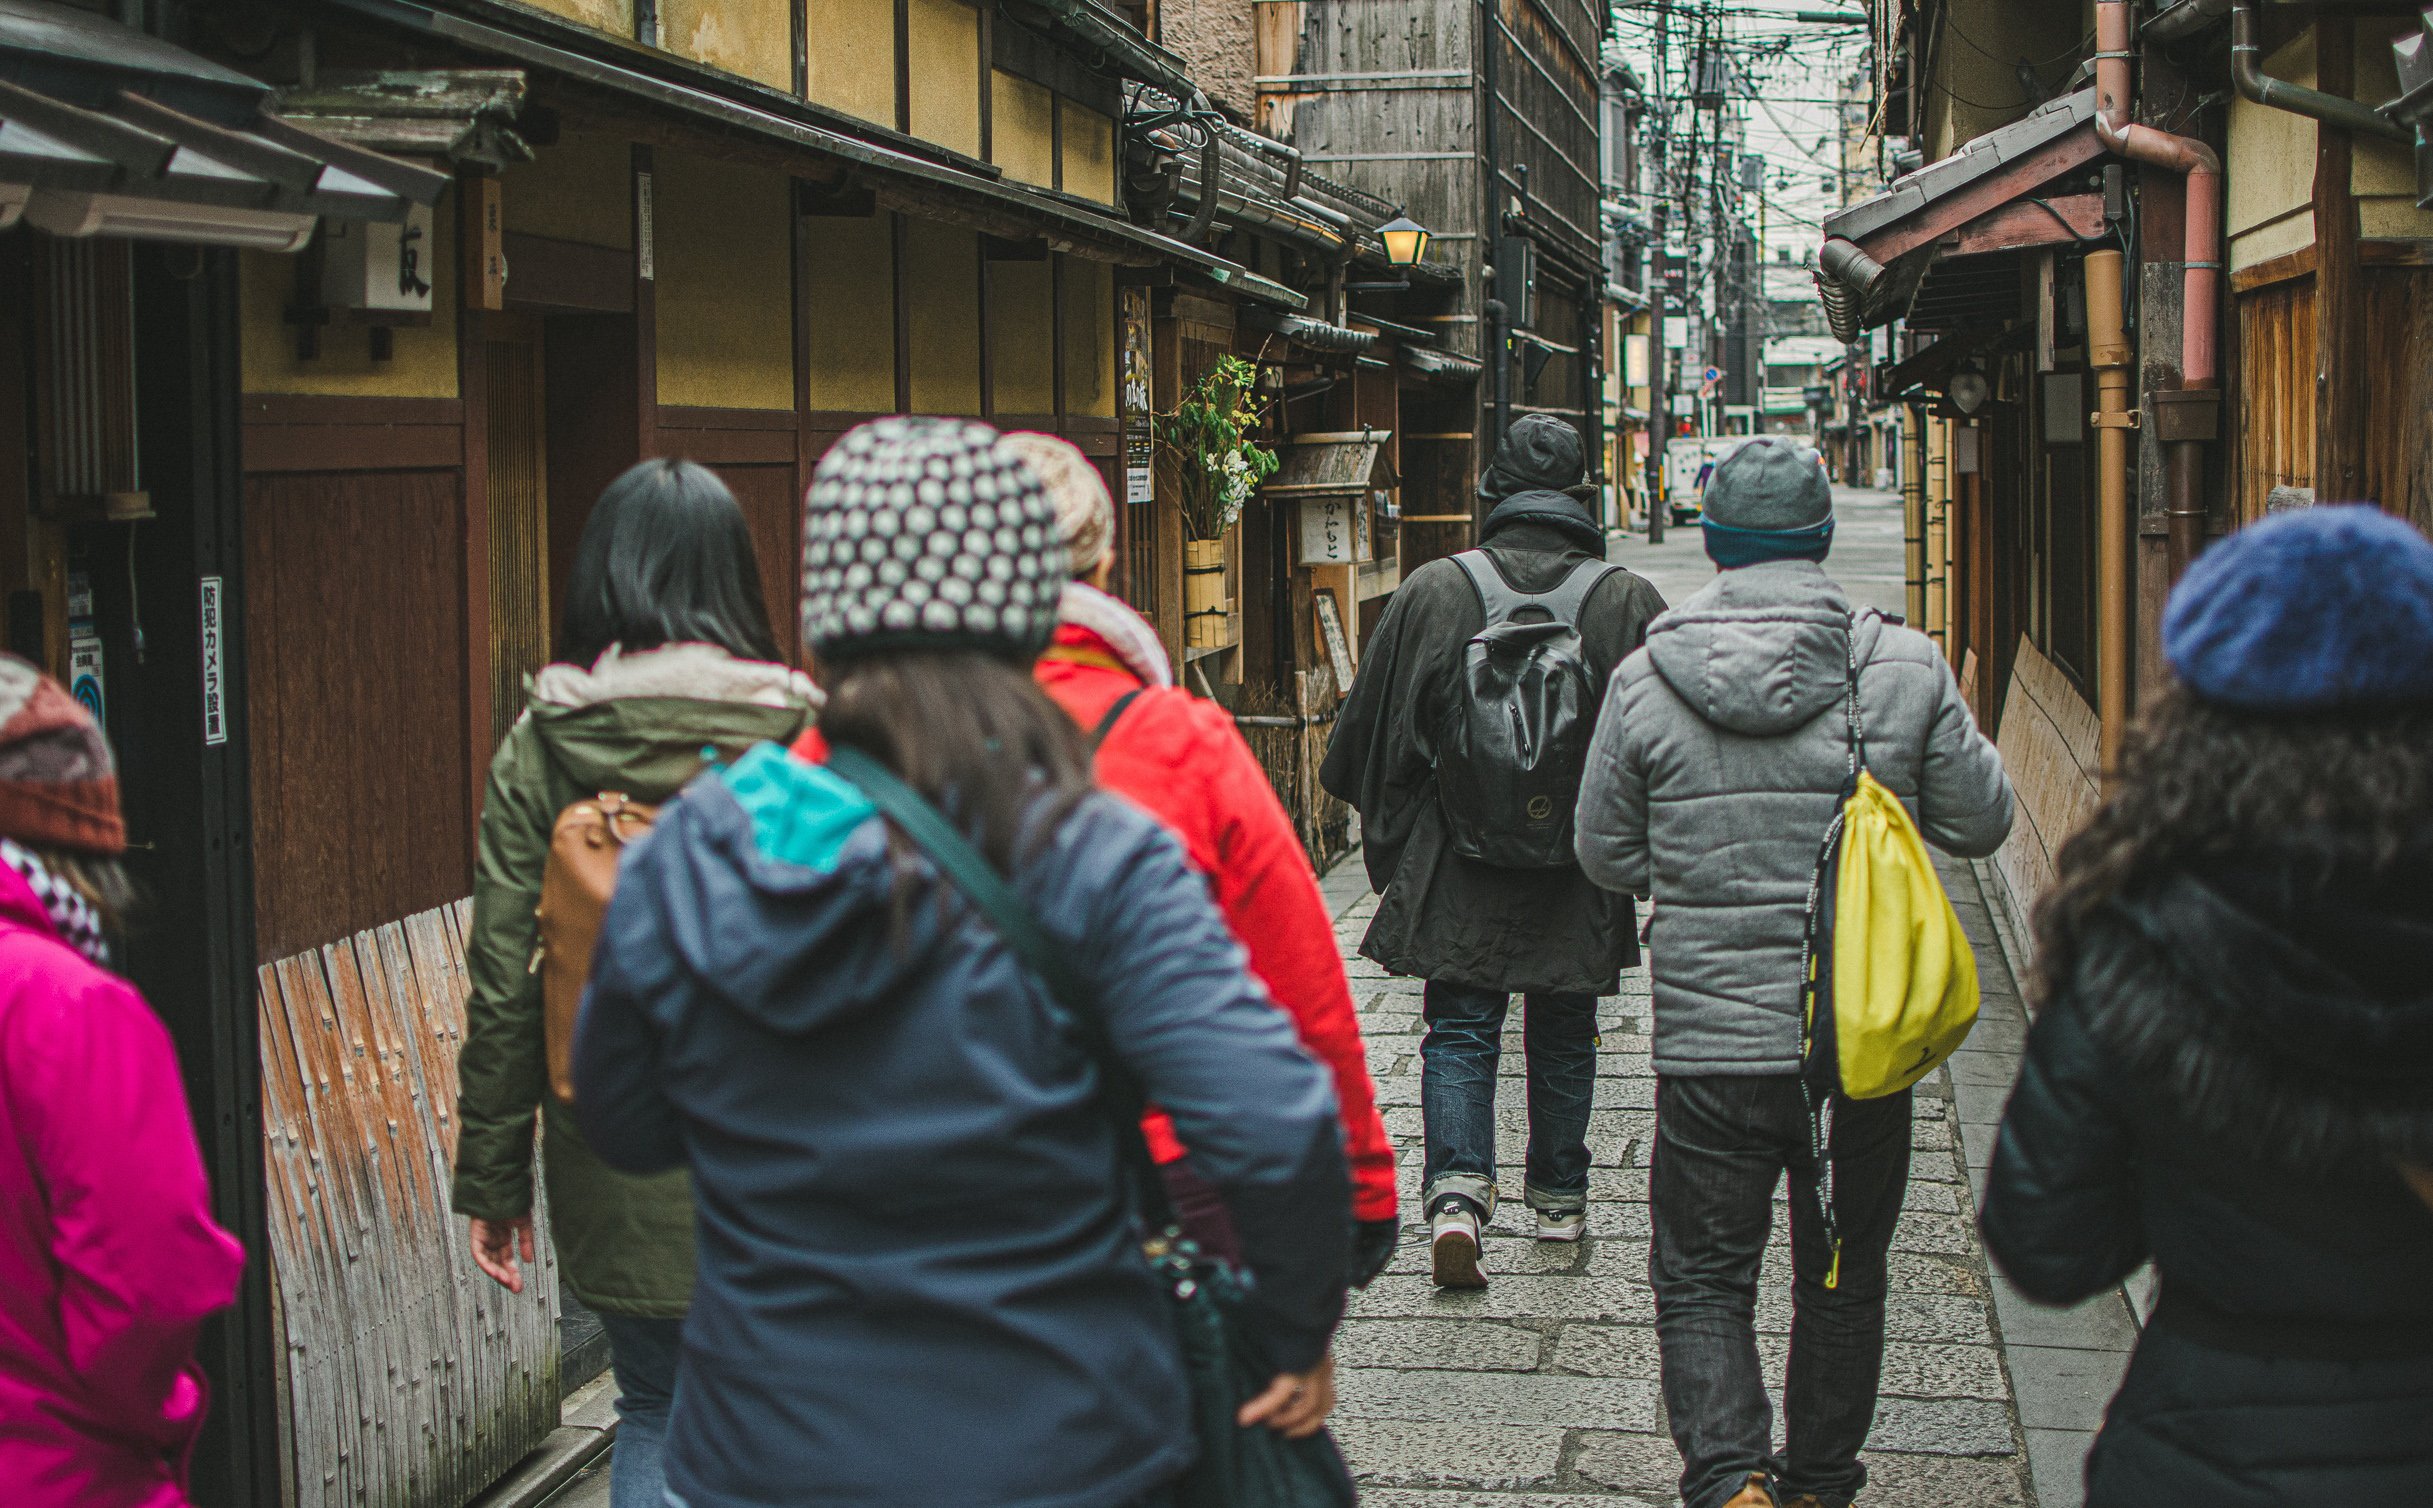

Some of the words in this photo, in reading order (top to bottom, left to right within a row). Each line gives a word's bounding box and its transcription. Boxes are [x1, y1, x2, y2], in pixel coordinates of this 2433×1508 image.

[203, 585, 220, 736] 防犯カメラ設置
